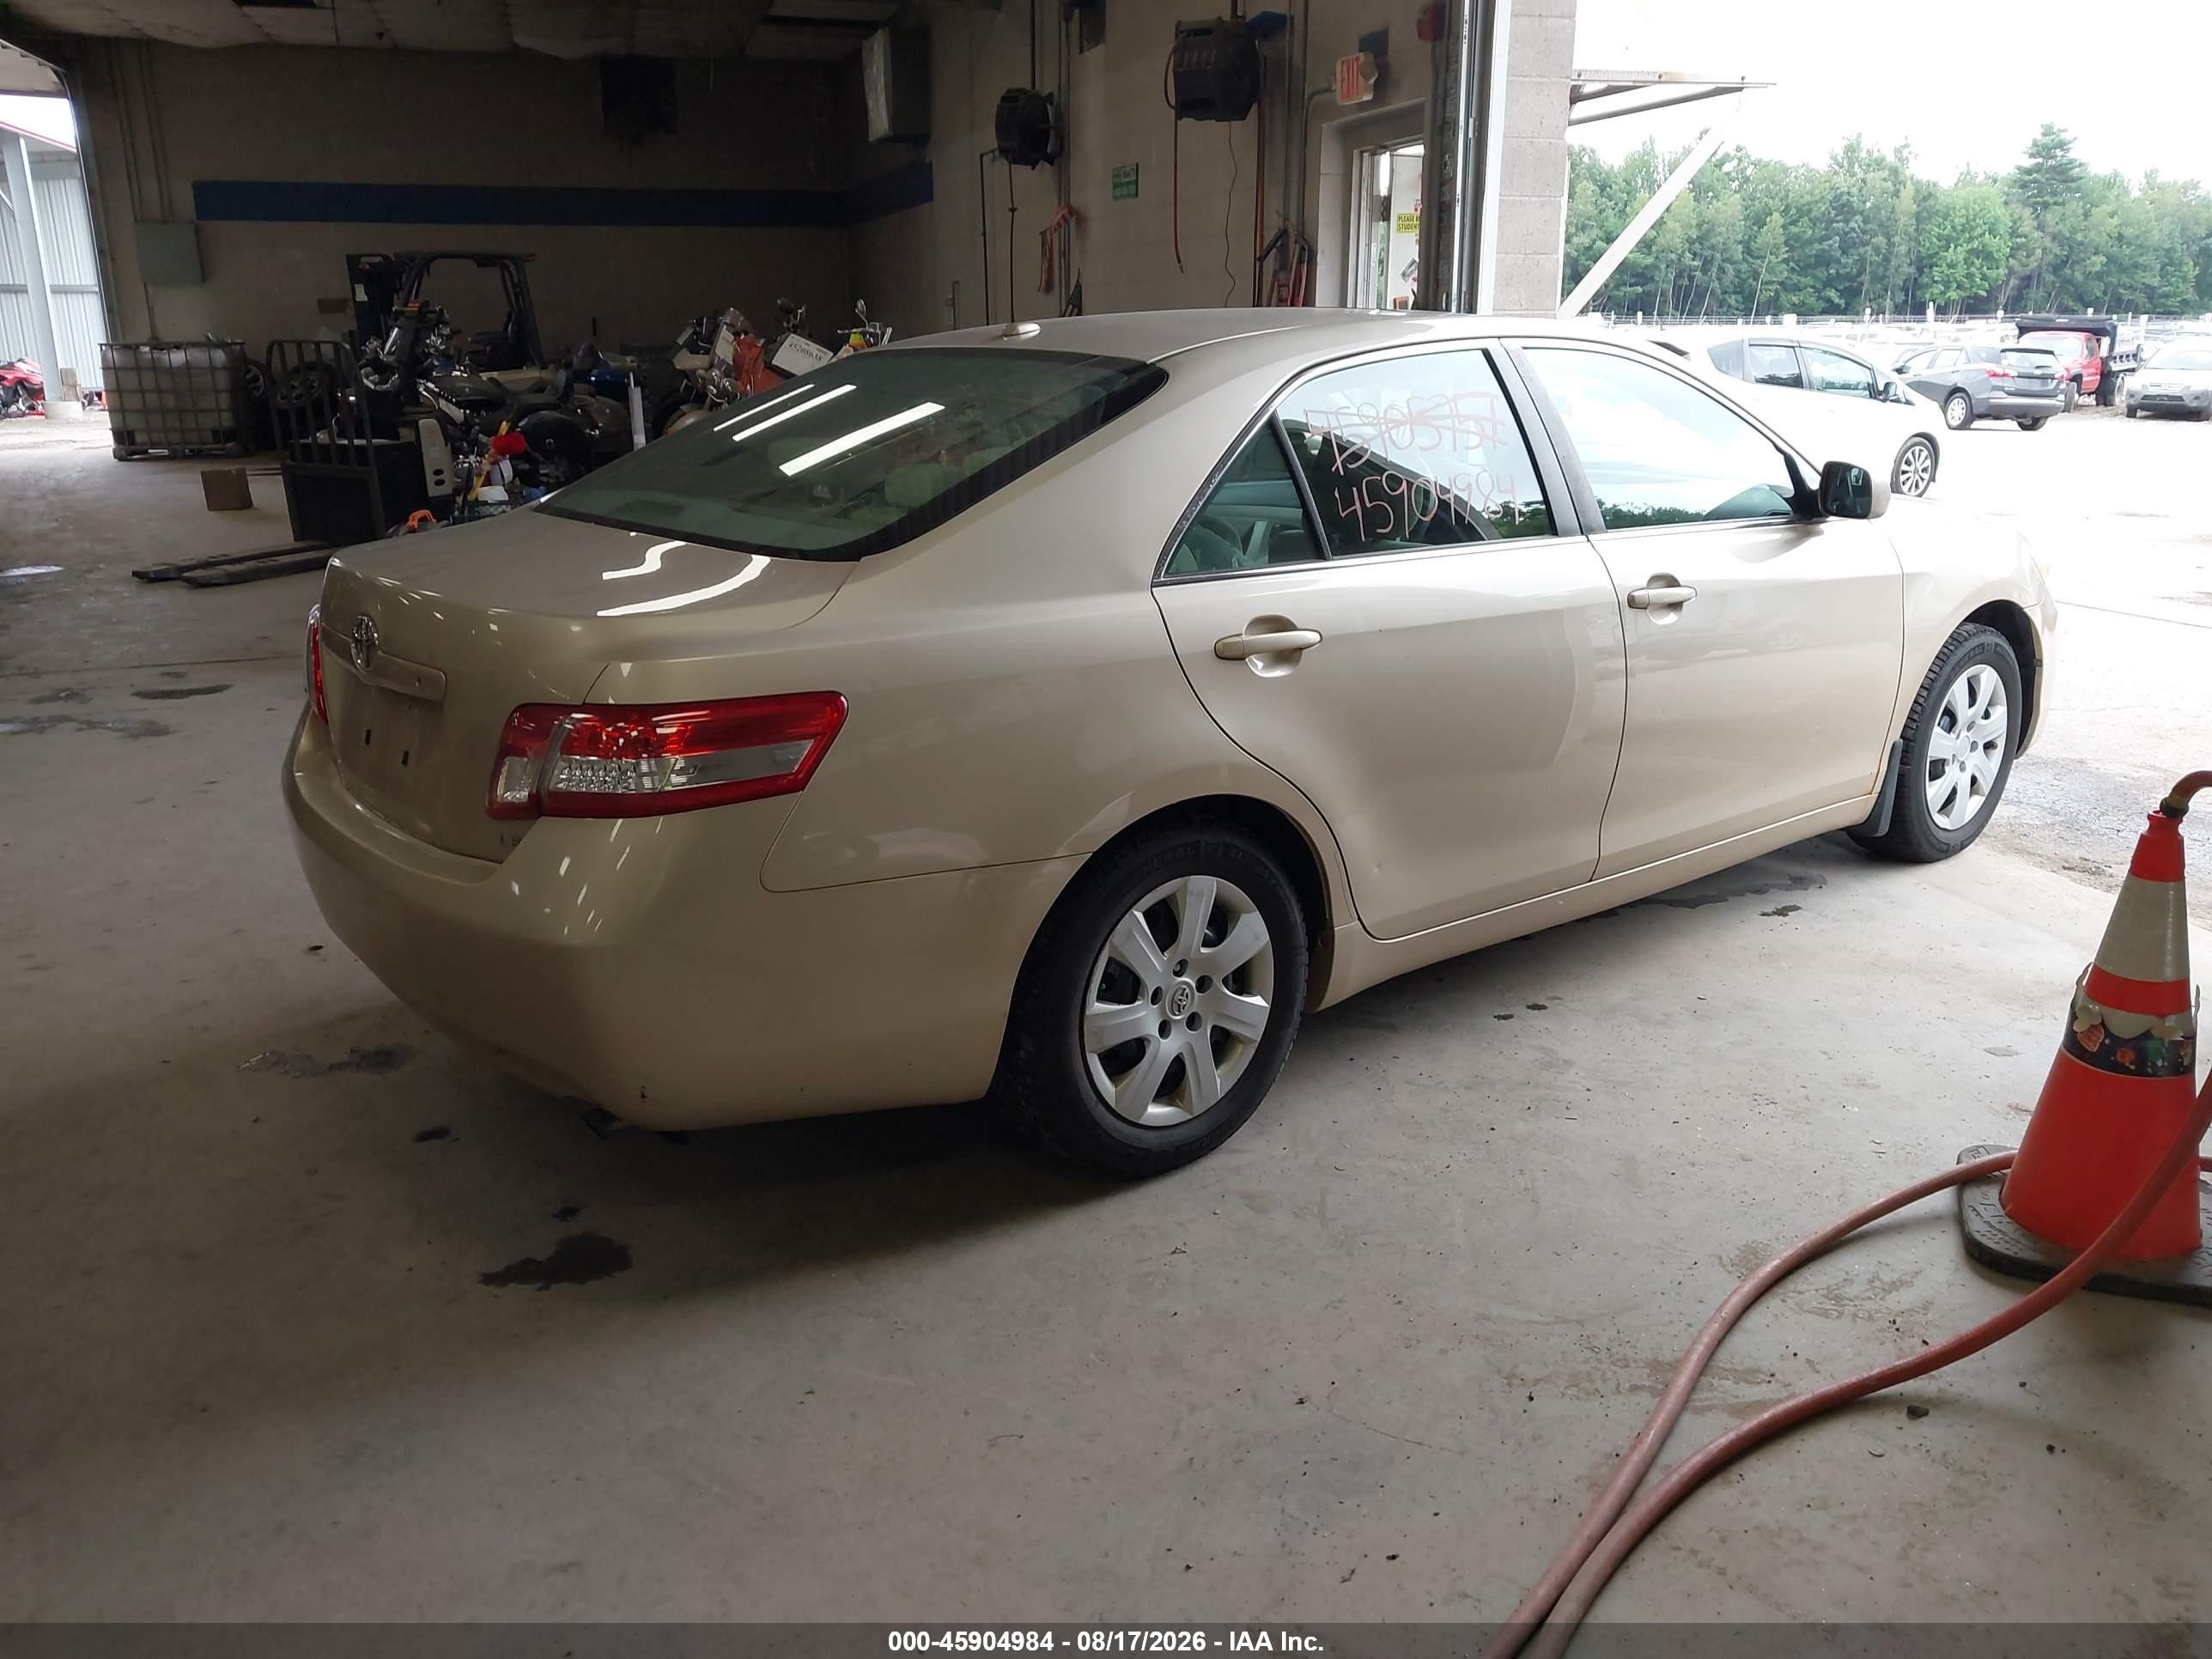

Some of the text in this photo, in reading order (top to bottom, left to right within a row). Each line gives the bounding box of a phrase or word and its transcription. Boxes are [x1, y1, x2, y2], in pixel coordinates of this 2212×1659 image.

[1340, 55, 1361, 100] EXIT
[1398, 215, 1414, 223] PLEASE
[1334, 467, 1519, 543] 45904984
